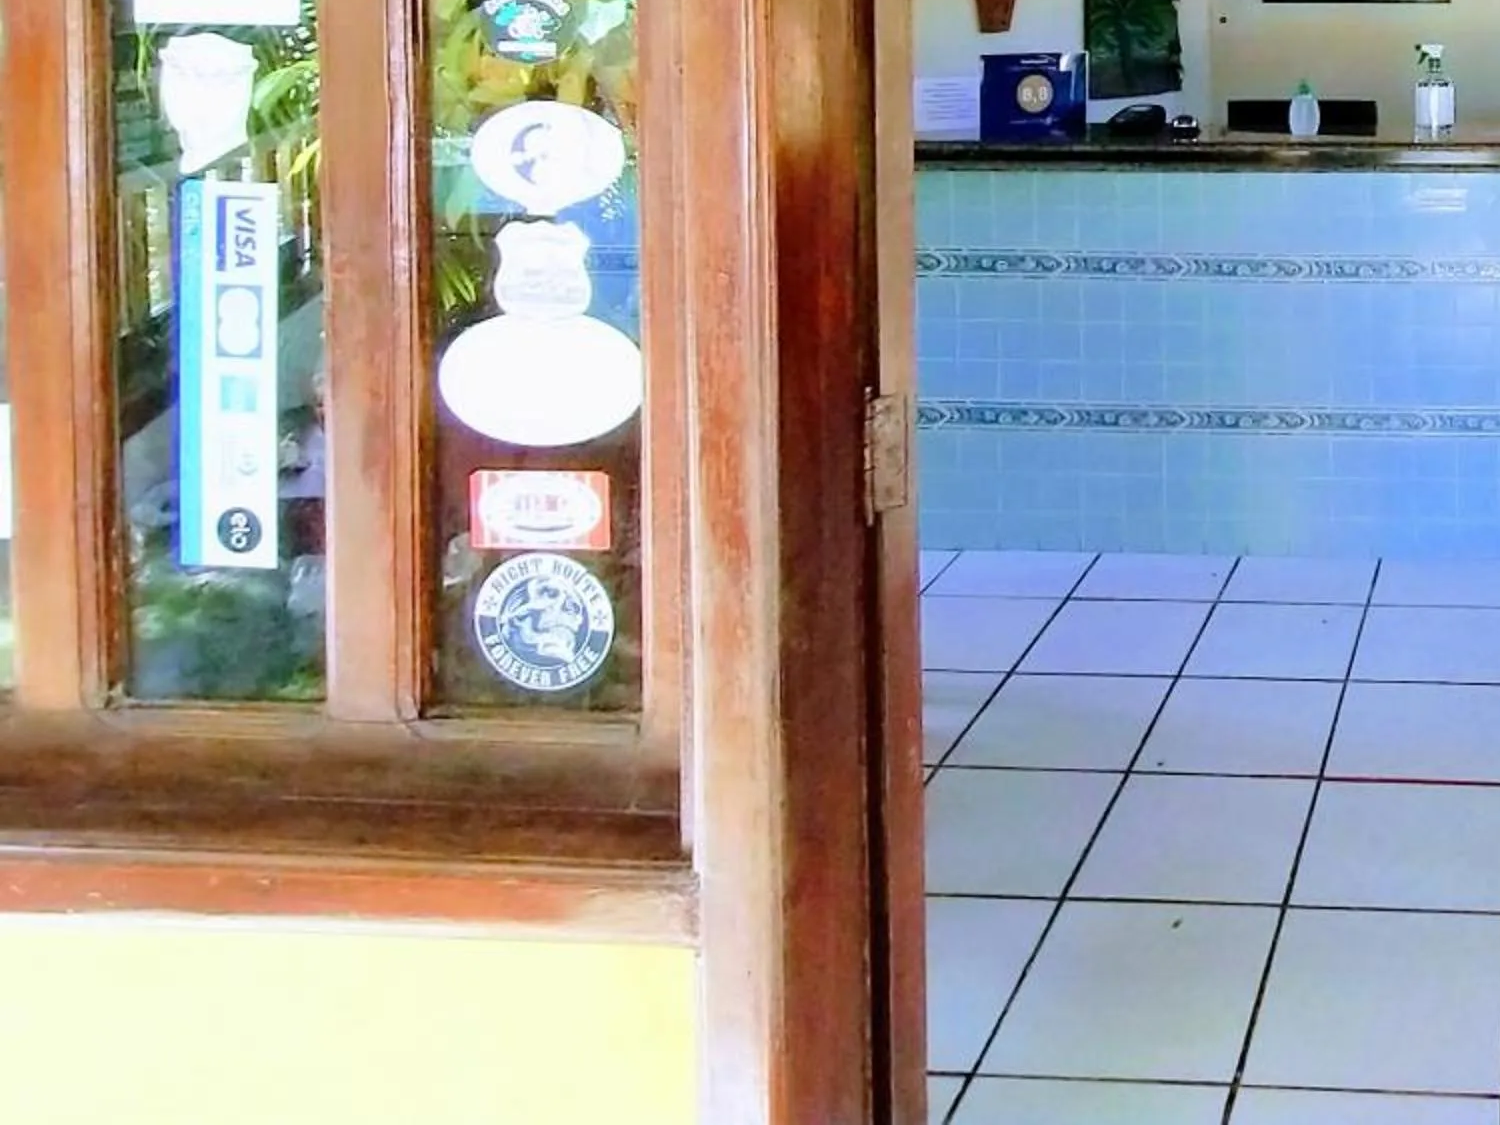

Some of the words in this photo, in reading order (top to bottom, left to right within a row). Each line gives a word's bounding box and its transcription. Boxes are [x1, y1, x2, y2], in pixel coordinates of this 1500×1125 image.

[235, 206, 256, 267] VISA
[229, 512, 251, 549] elo
[553, 559, 600, 602] ROUTE
[484, 634, 551, 686] FOREVER
[558, 646, 600, 683] FREE
